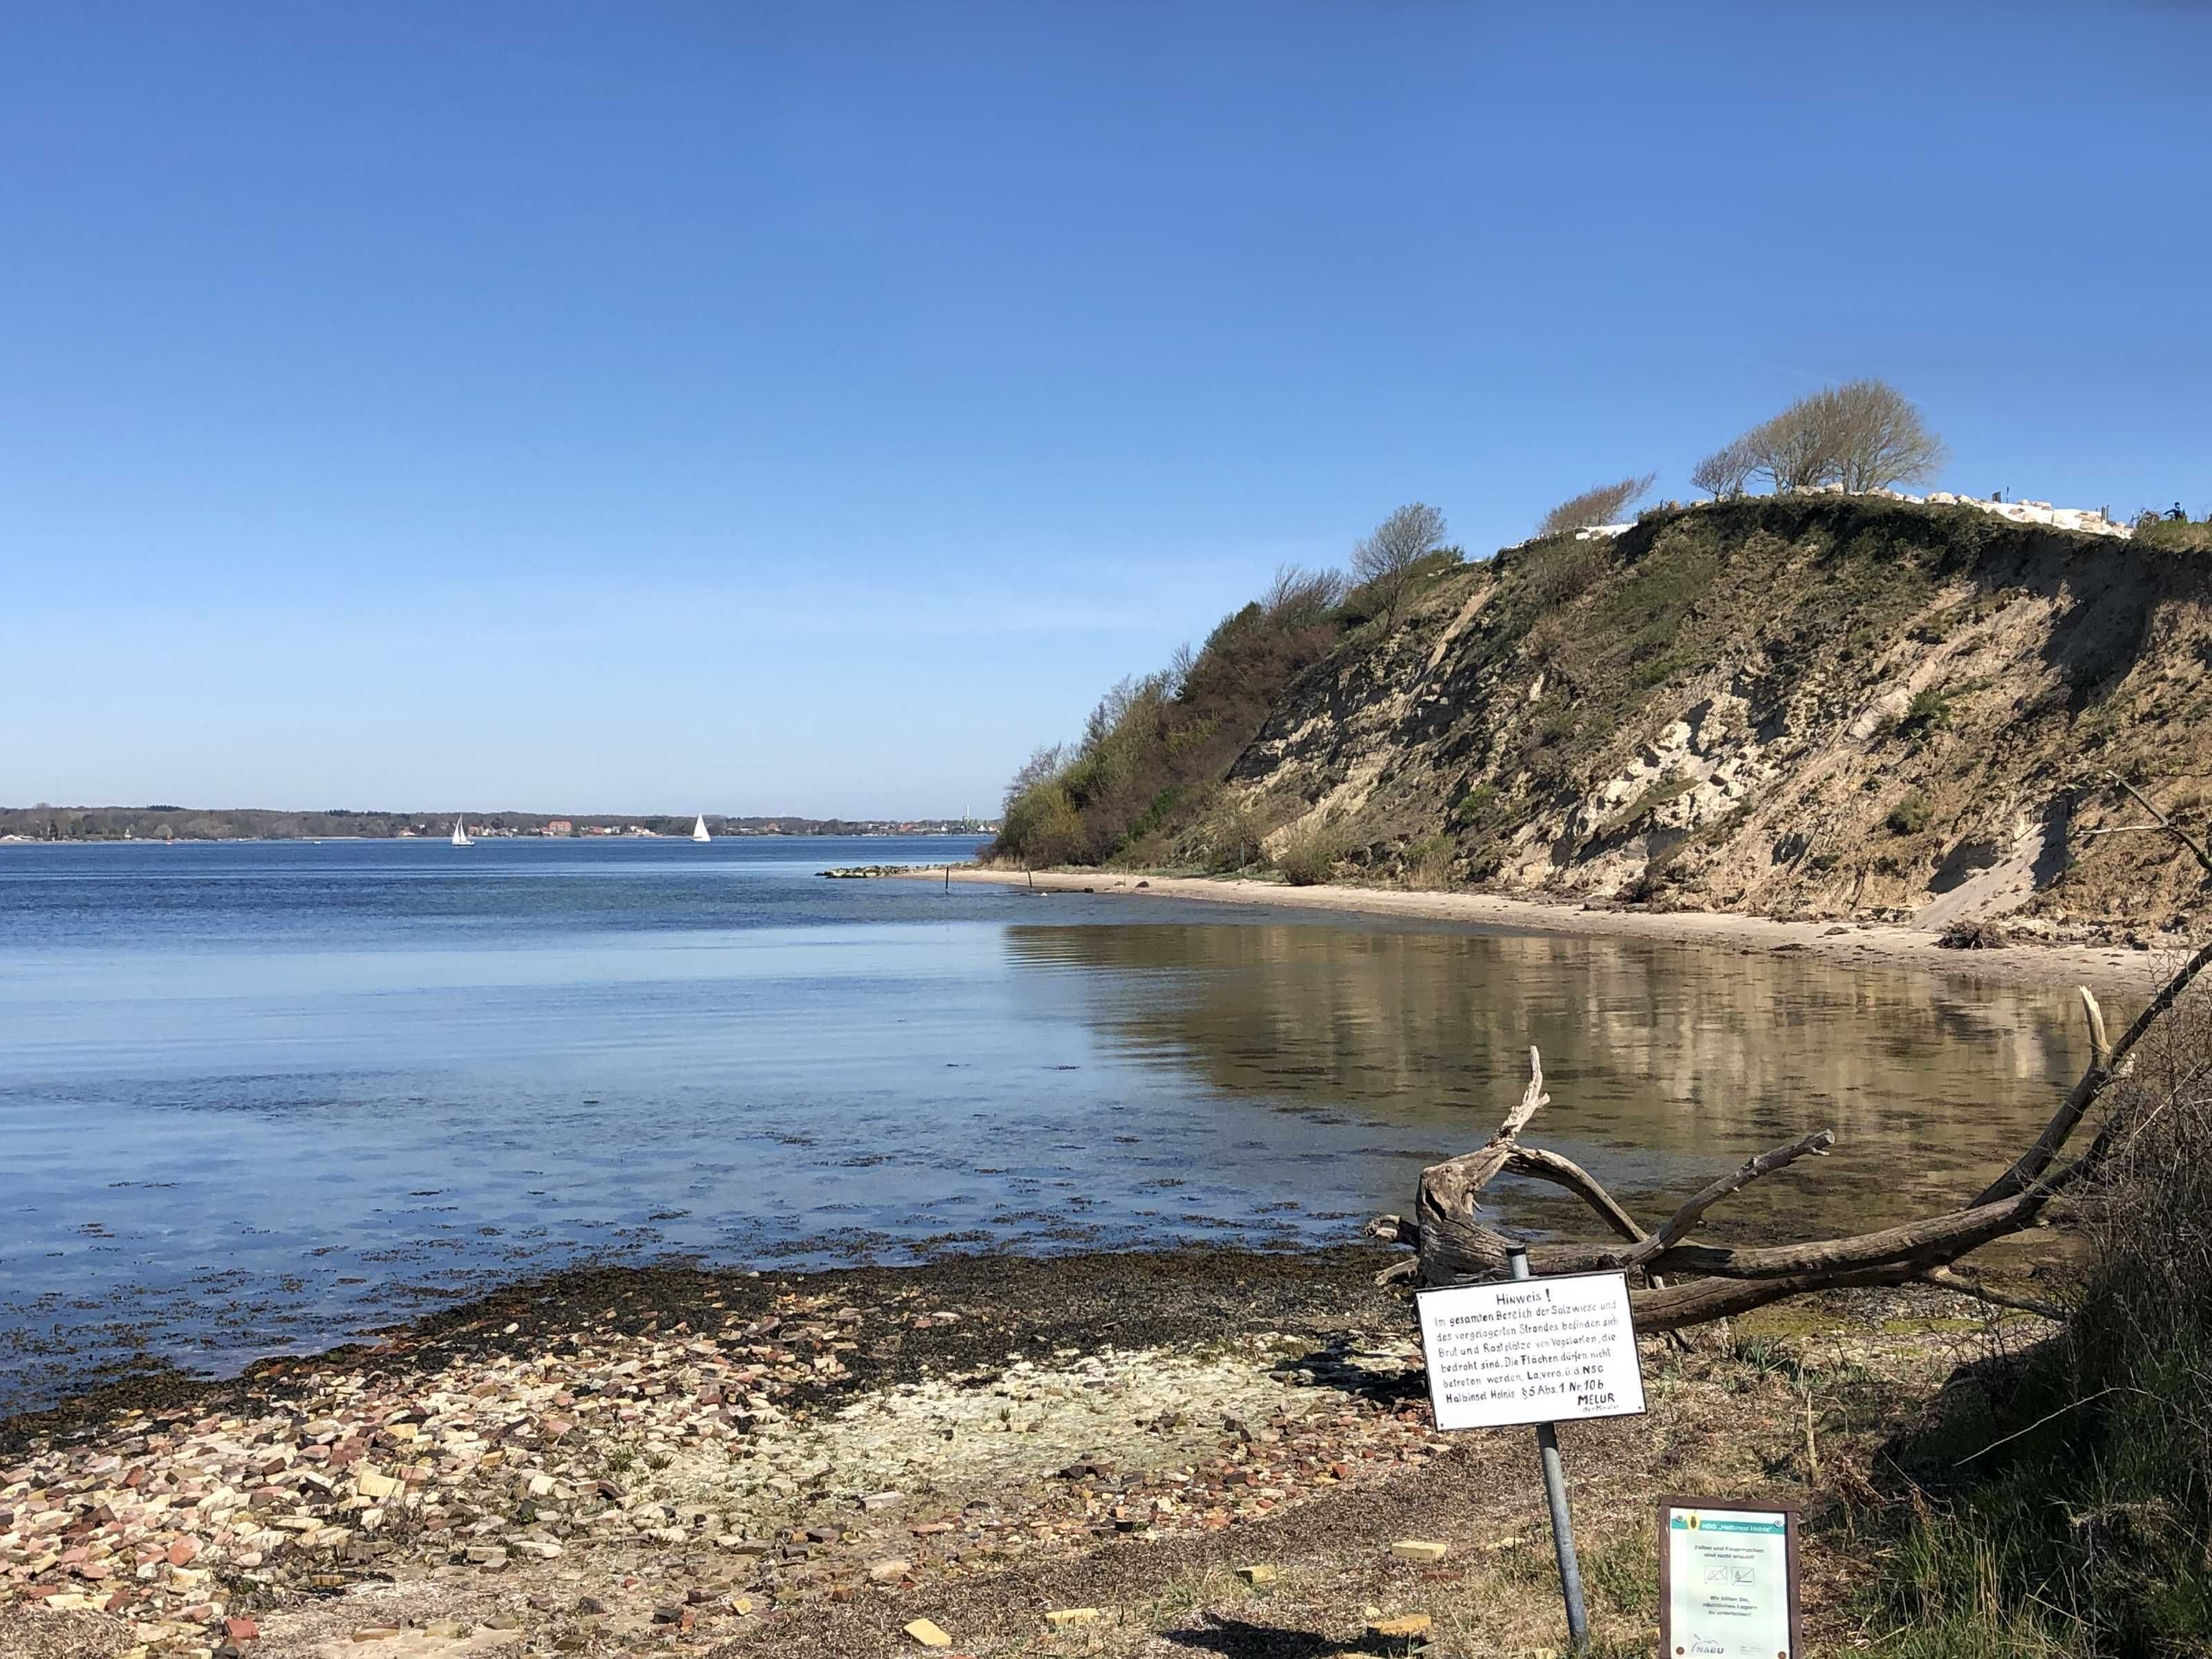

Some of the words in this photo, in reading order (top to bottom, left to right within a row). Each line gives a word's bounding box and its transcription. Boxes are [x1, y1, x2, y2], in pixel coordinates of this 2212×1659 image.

[1435, 1317, 1445, 1327] Im
[1450, 1313, 1494, 1327] gesamten
[1496, 1308, 1532, 1320] Bereich
[1536, 1307, 1549, 1316] der
[1551, 1304, 1596, 1315] Salzwiese
[1600, 1300, 1616, 1310] und
[1437, 1332, 1452, 1342] des
[1455, 1327, 1517, 1342] vorgelagerten
[1519, 1322, 1559, 1334] Strandes
[1562, 1318, 1600, 1331] befinden
[1603, 1315, 1618, 1327] sich
[1438, 1347, 1458, 1358] Brut
[1461, 1344, 1479, 1355] und
[1602, 1333, 1616, 1342] die
[1441, 1361, 1478, 1373] bedroht
[1504, 1356, 1519, 1367] Die
[1521, 1354, 1559, 1365] Flächen
[1561, 1351, 1588, 1362] dürfen
[1591, 1347, 1611, 1358] nicht
[1443, 1378, 1481, 1388] betreten
[1583, 1365, 1604, 1374] NSG
[1446, 1391, 1487, 1403] Halbinsel
[1490, 1389, 1515, 1399] Holnis
[1577, 1392, 1615, 1405] MELUR
